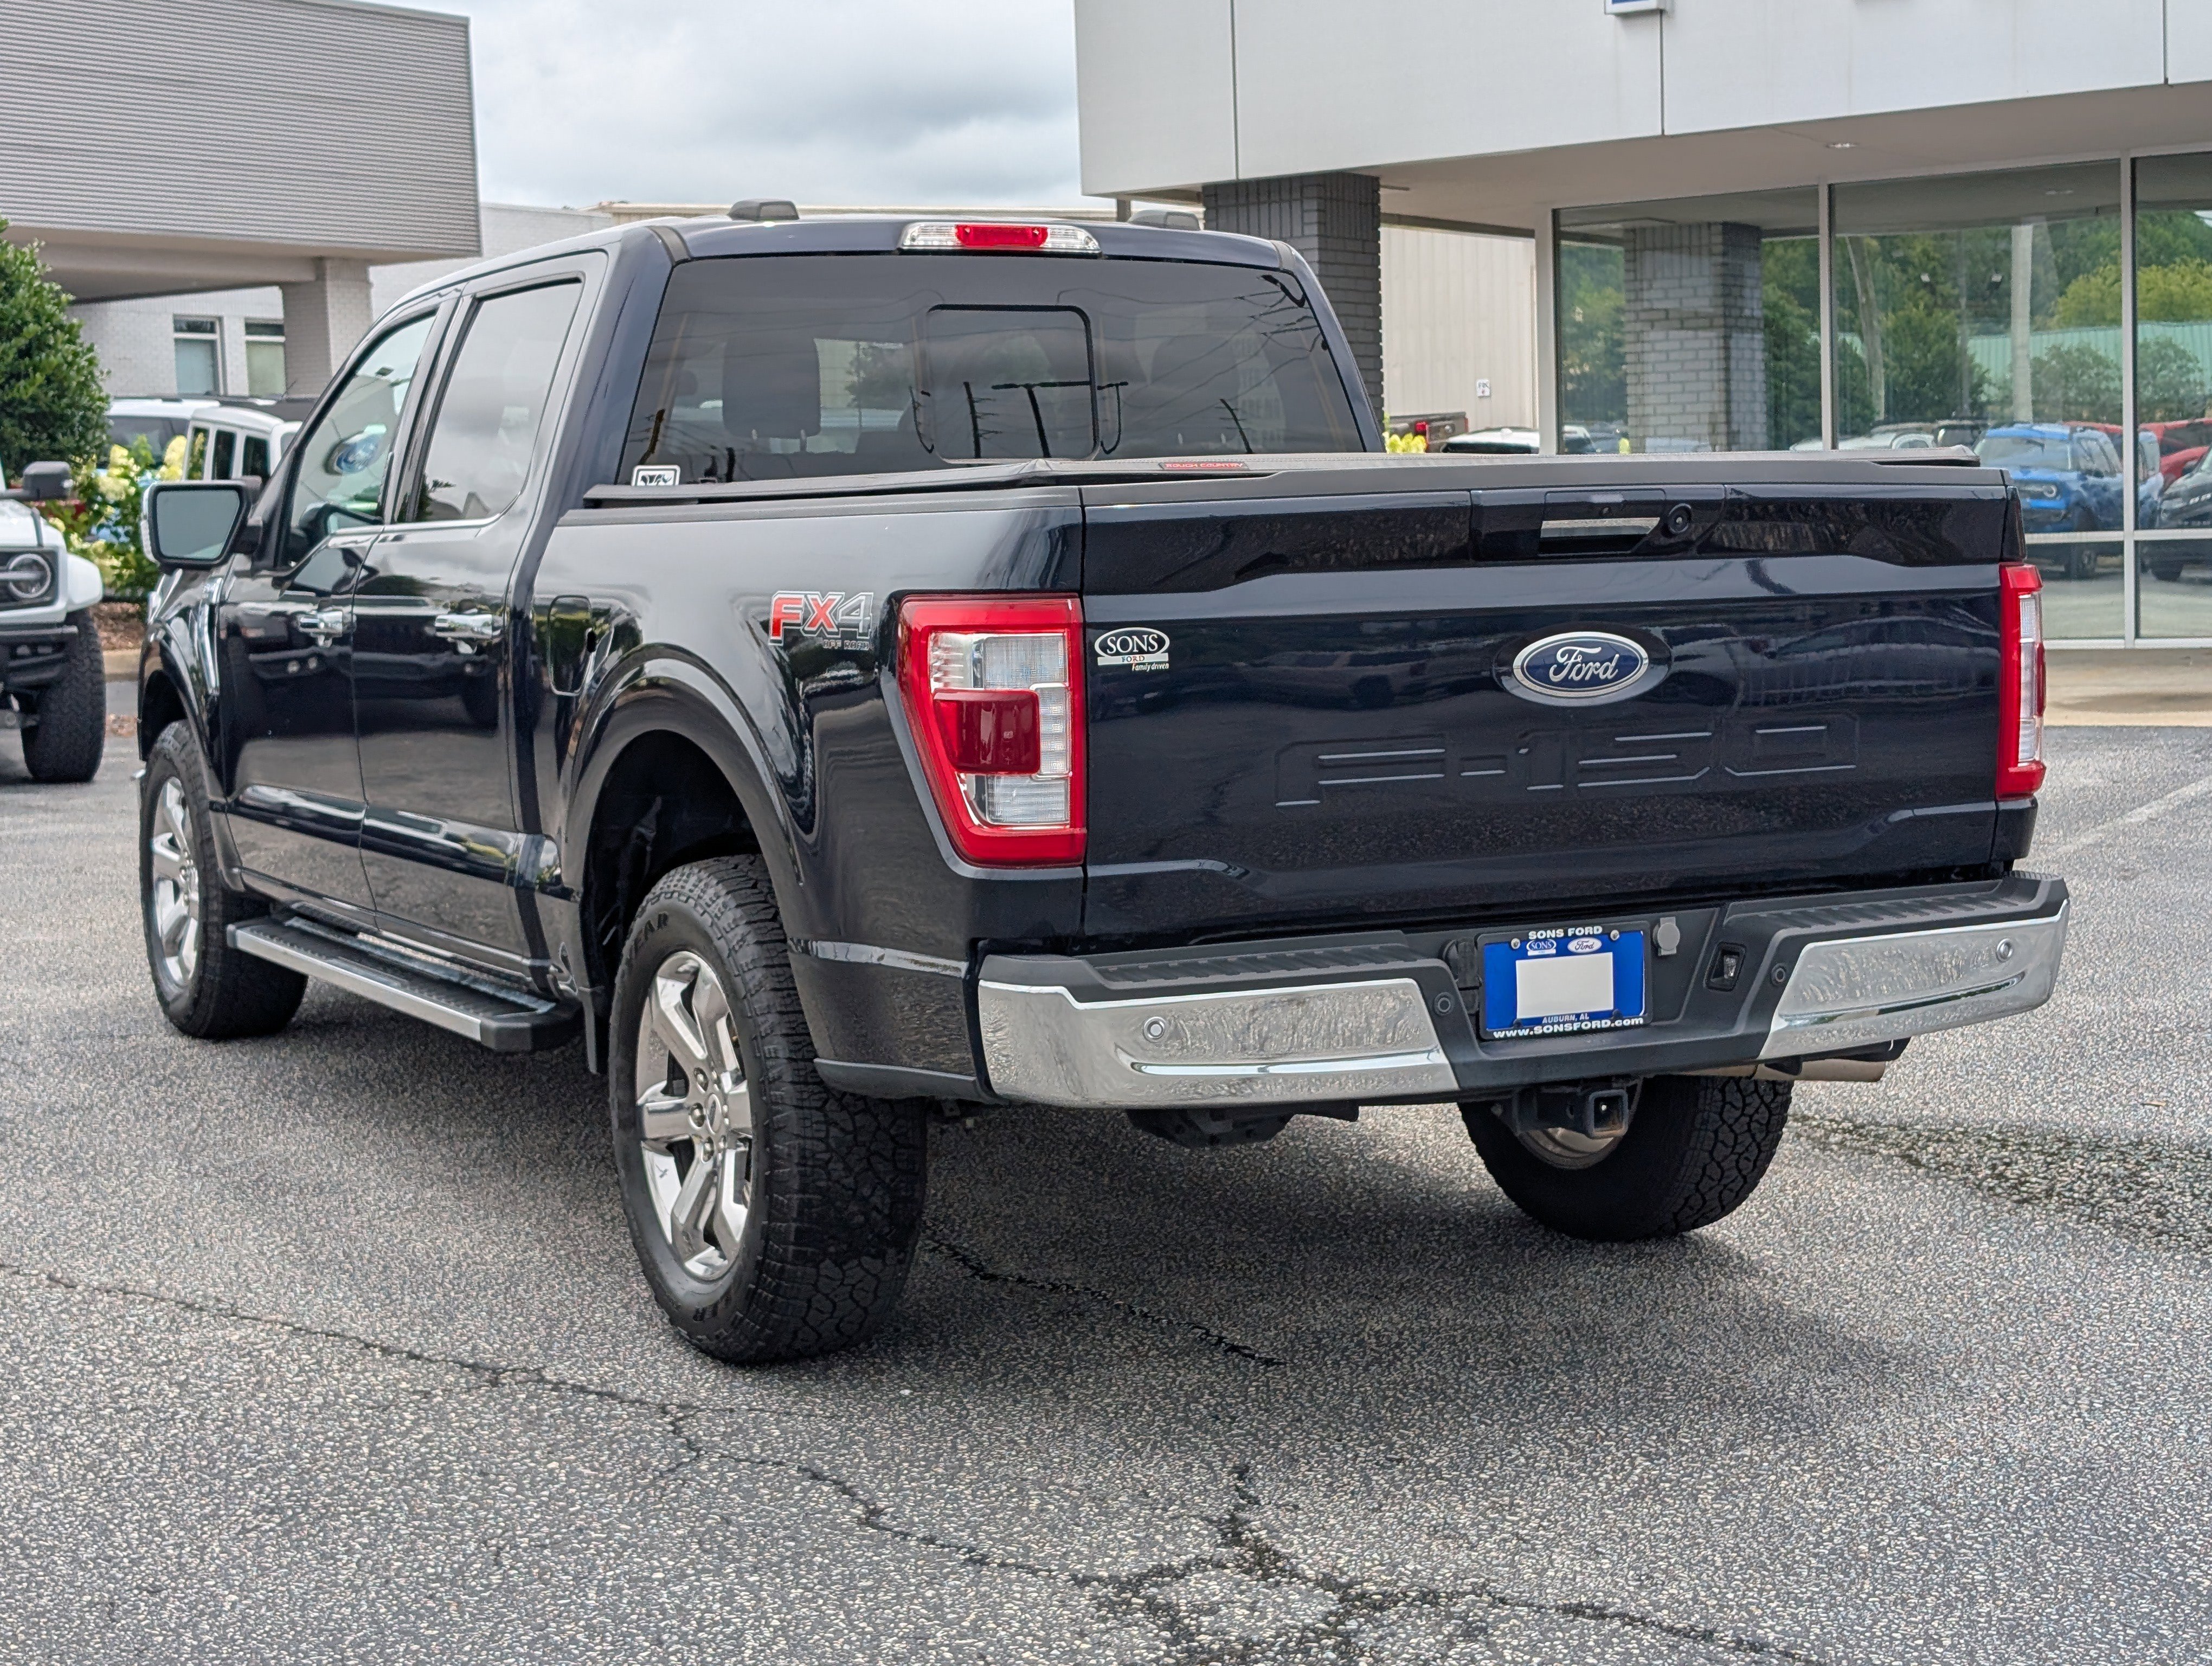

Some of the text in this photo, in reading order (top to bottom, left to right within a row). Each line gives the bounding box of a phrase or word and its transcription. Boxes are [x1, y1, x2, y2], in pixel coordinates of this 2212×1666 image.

[768, 591, 873, 645] FX4
[1107, 634, 1158, 654] SONS
[1549, 646, 1619, 682] Ford
[1528, 926, 1603, 939] SONS FORD
[1531, 940, 1552, 950] SONS
[1574, 940, 1595, 950] Ford
[1542, 1015, 1577, 1023] AUBURN,
[1493, 1017, 1643, 1039] www.SONSFORD.com
